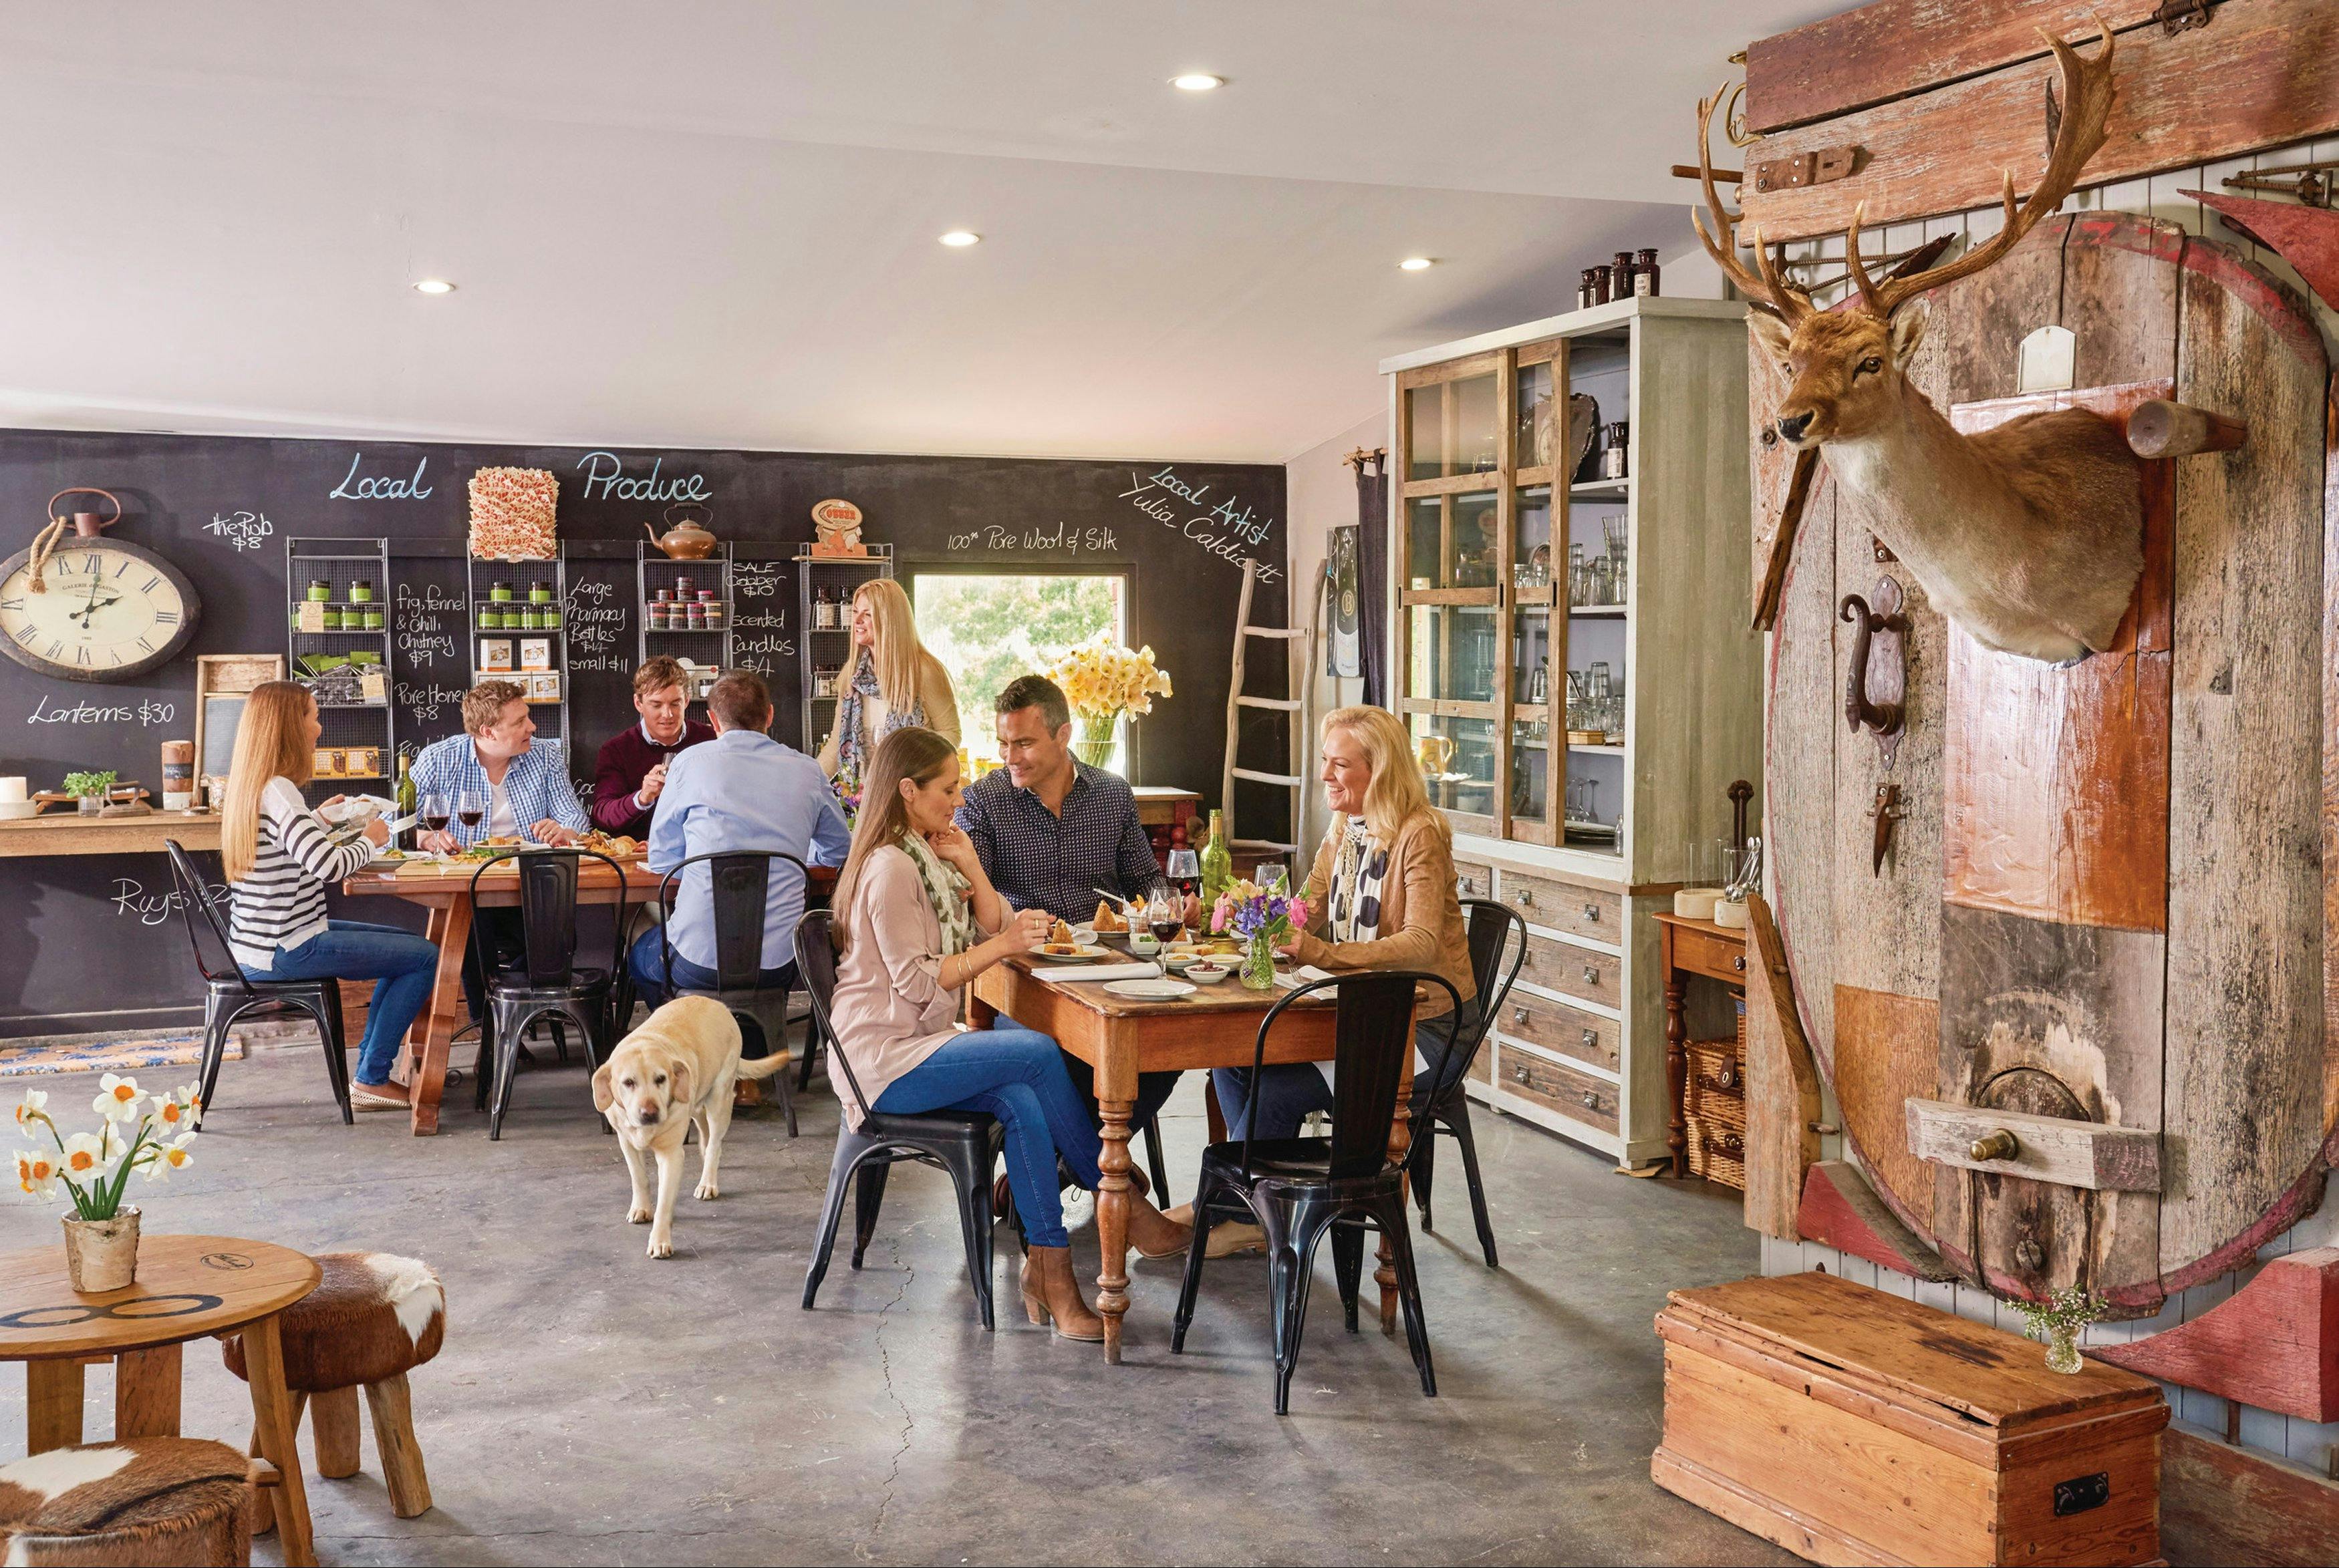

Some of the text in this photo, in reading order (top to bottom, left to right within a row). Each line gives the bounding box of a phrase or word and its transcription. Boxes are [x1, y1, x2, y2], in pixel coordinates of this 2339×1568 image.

[330, 452, 432, 499] Local
[577, 452, 712, 501] Produce
[1148, 466, 1272, 546] Local Artist
[233, 511, 273, 538] Rub
[1118, 472, 1283, 584] Yulia Caldictt
[232, 534, 263, 552] $8
[948, 521, 1117, 555] 100% Pure Wool & Silk
[733, 562, 781, 573] SALE
[62, 583, 87, 591] GALERIE
[570, 576, 612, 605] Large
[743, 585, 775, 597] $10
[396, 614, 407, 631] &
[563, 596, 626, 631] Pharmacy
[398, 633, 456, 657] Chutney
[569, 622, 615, 645] Bottles
[580, 639, 609, 653] $14
[732, 635, 795, 656] Candles
[408, 649, 433, 669] $9
[608, 655, 628, 674] $11
[741, 655, 775, 678] $4
[394, 682, 426, 705] Pure
[27, 694, 174, 727] Lanterns $30
[413, 705, 440, 726] $8
[110, 878, 190, 925] Rugs
